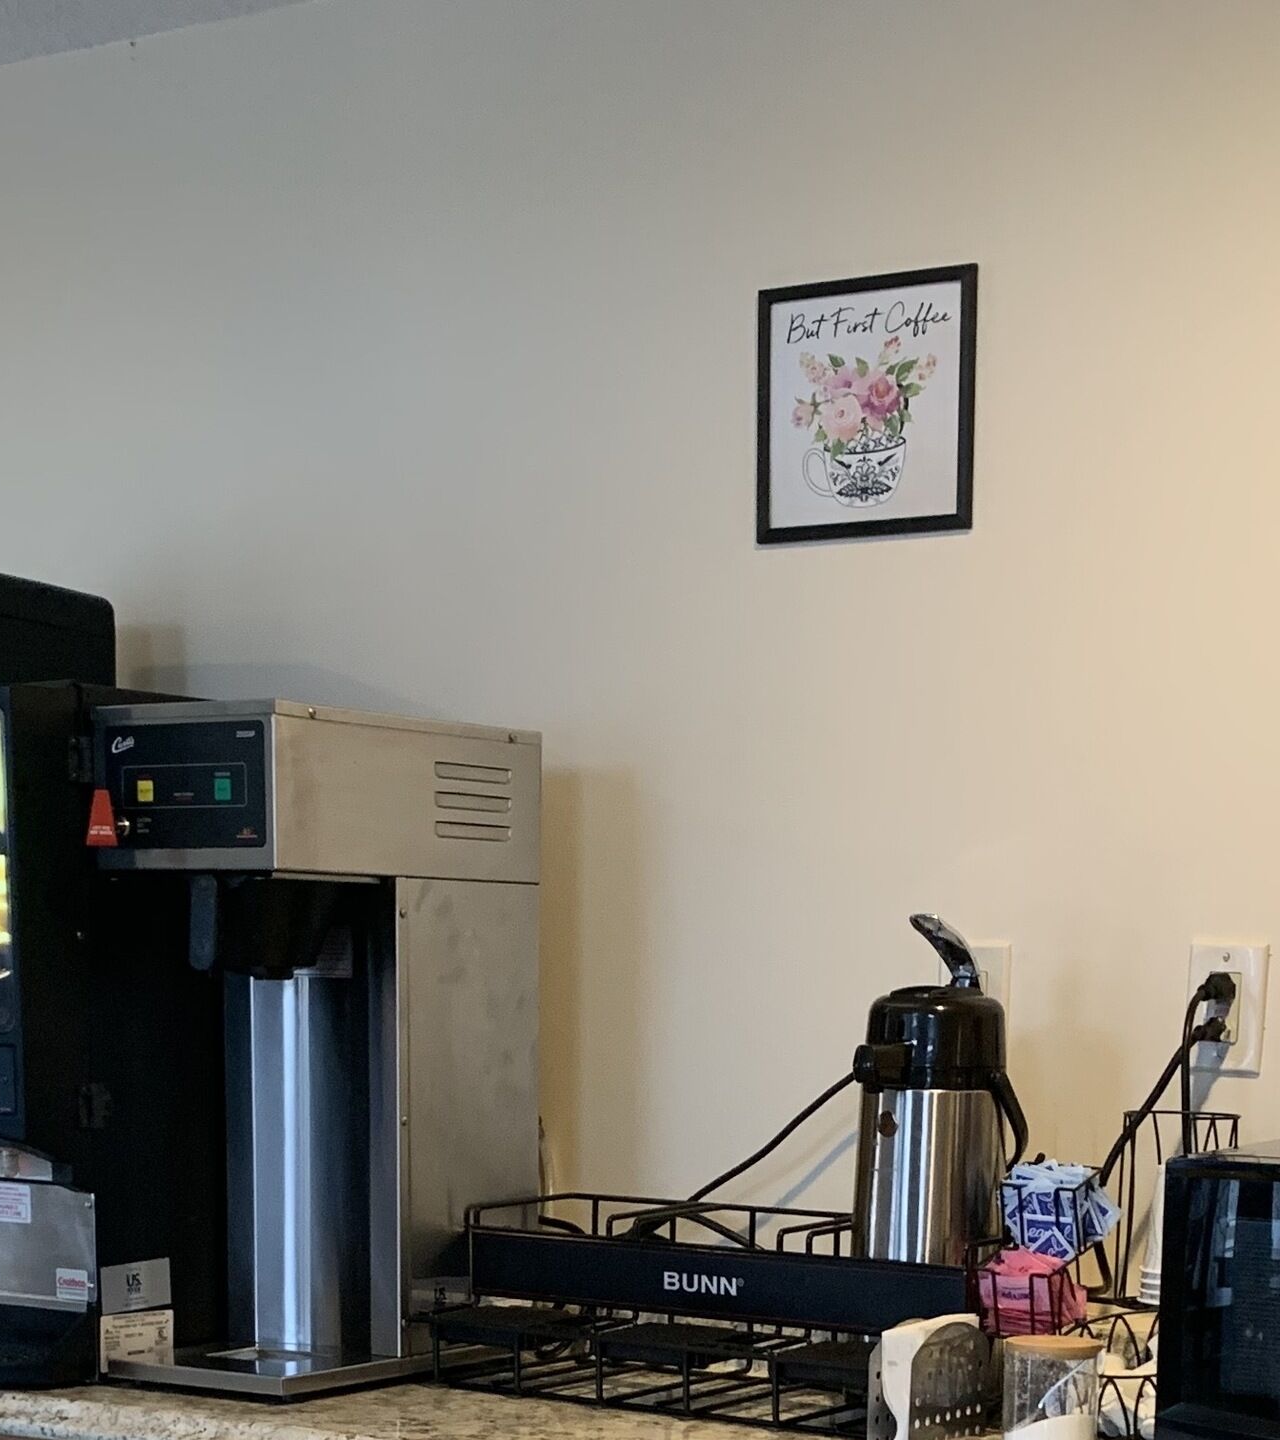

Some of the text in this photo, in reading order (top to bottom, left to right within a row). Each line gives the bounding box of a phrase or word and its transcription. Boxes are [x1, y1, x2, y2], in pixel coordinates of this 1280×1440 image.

[786, 300, 953, 345] But First Coffee
[663, 1270, 738, 1297] BUNN
